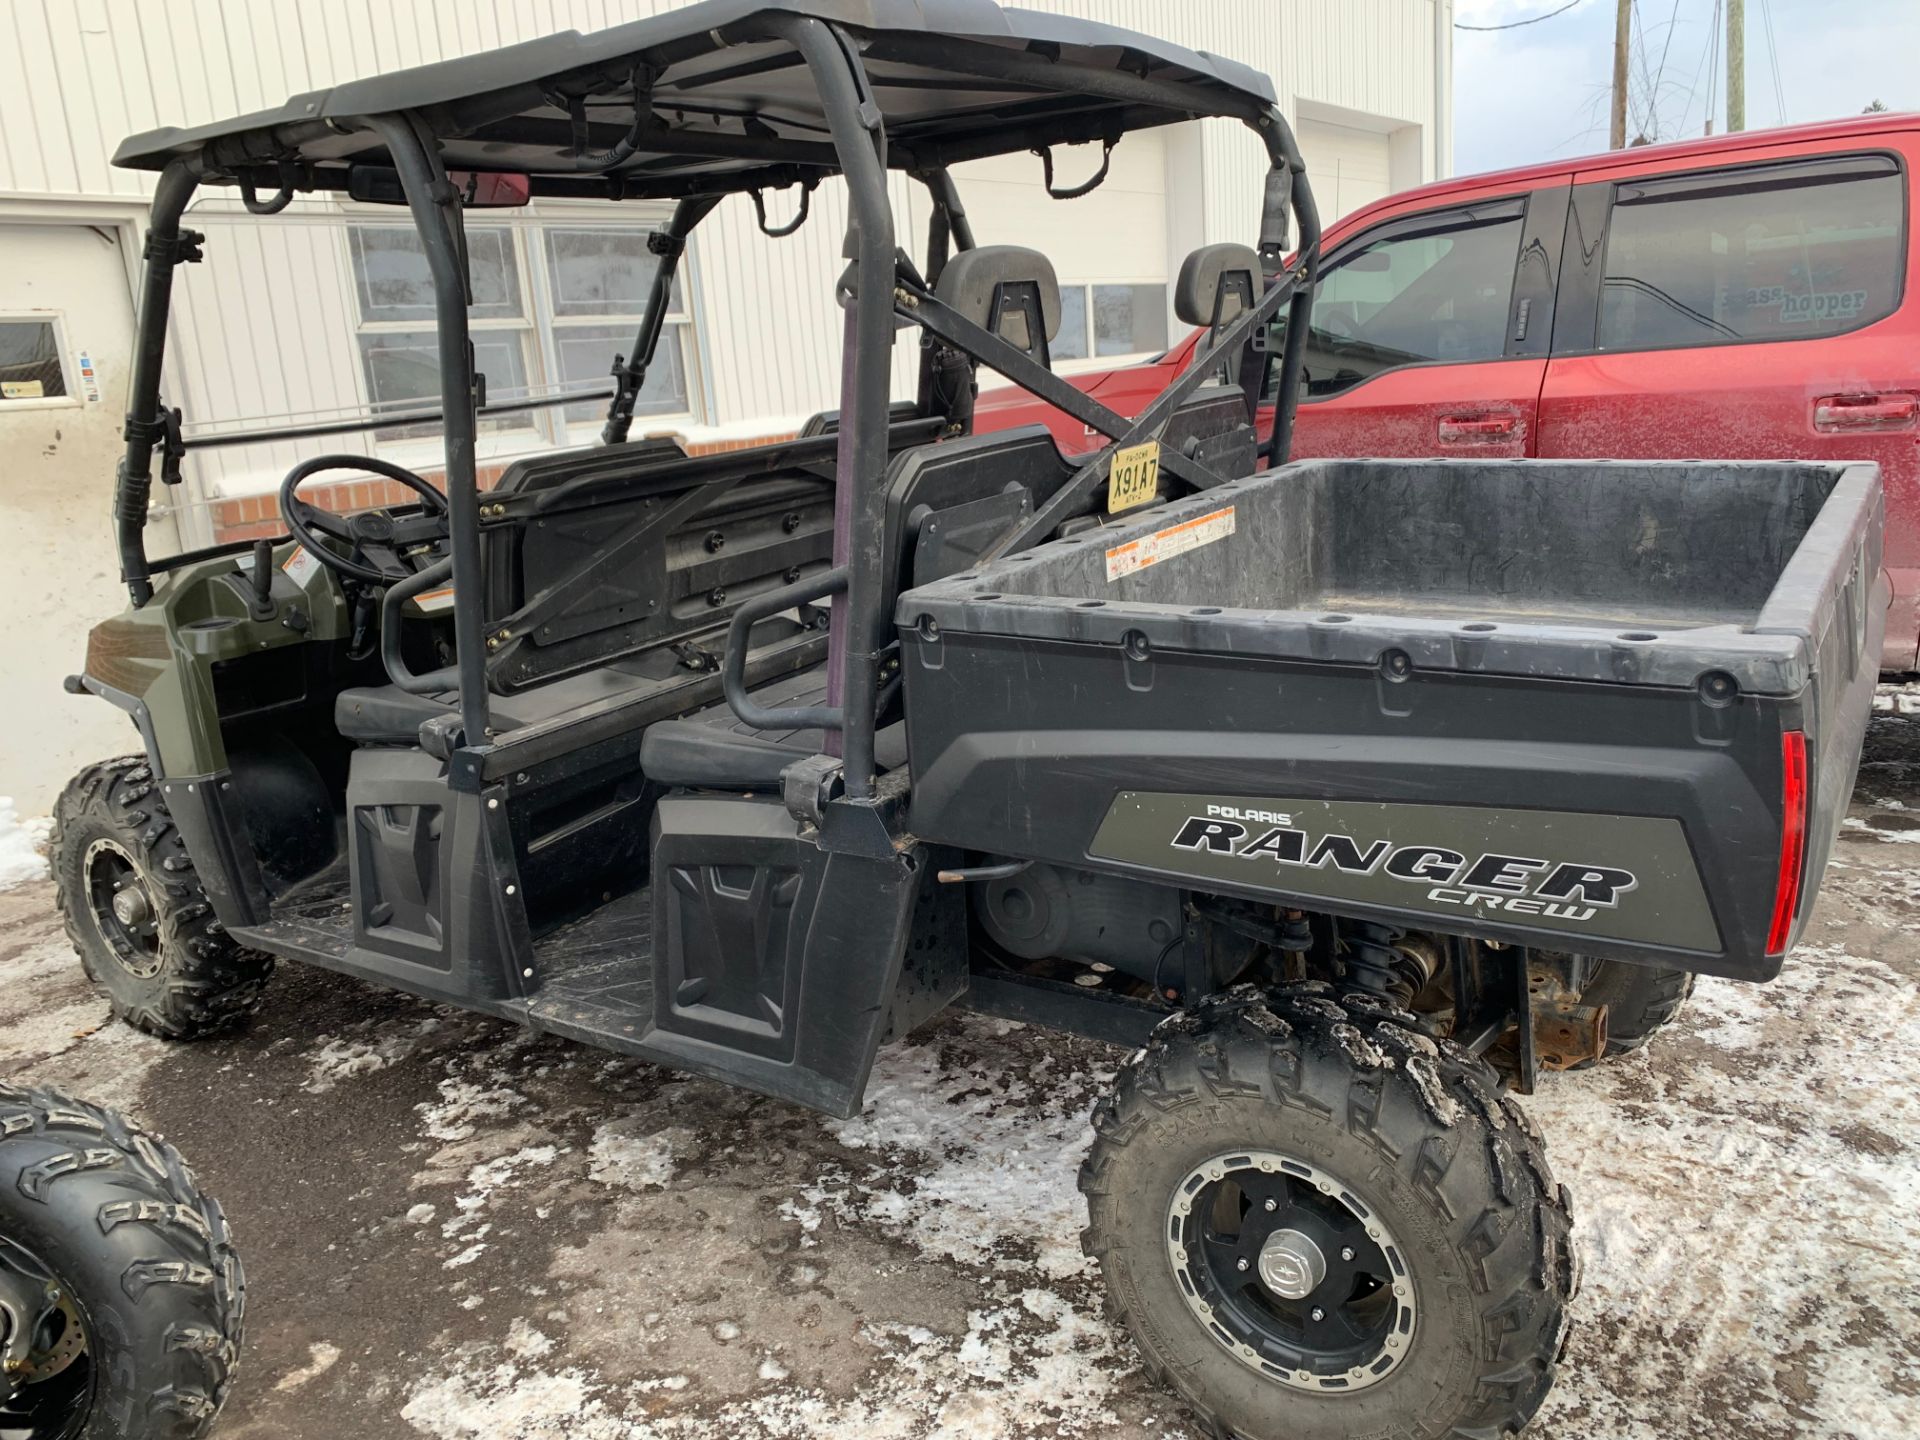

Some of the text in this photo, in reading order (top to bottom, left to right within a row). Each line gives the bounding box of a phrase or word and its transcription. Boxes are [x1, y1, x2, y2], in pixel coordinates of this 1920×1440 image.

[1114, 458, 1157, 499] X91A7
[1206, 804, 1292, 826] POLARIS
[1170, 815, 1639, 909] RANGER
[1426, 887, 1597, 921] CREW
